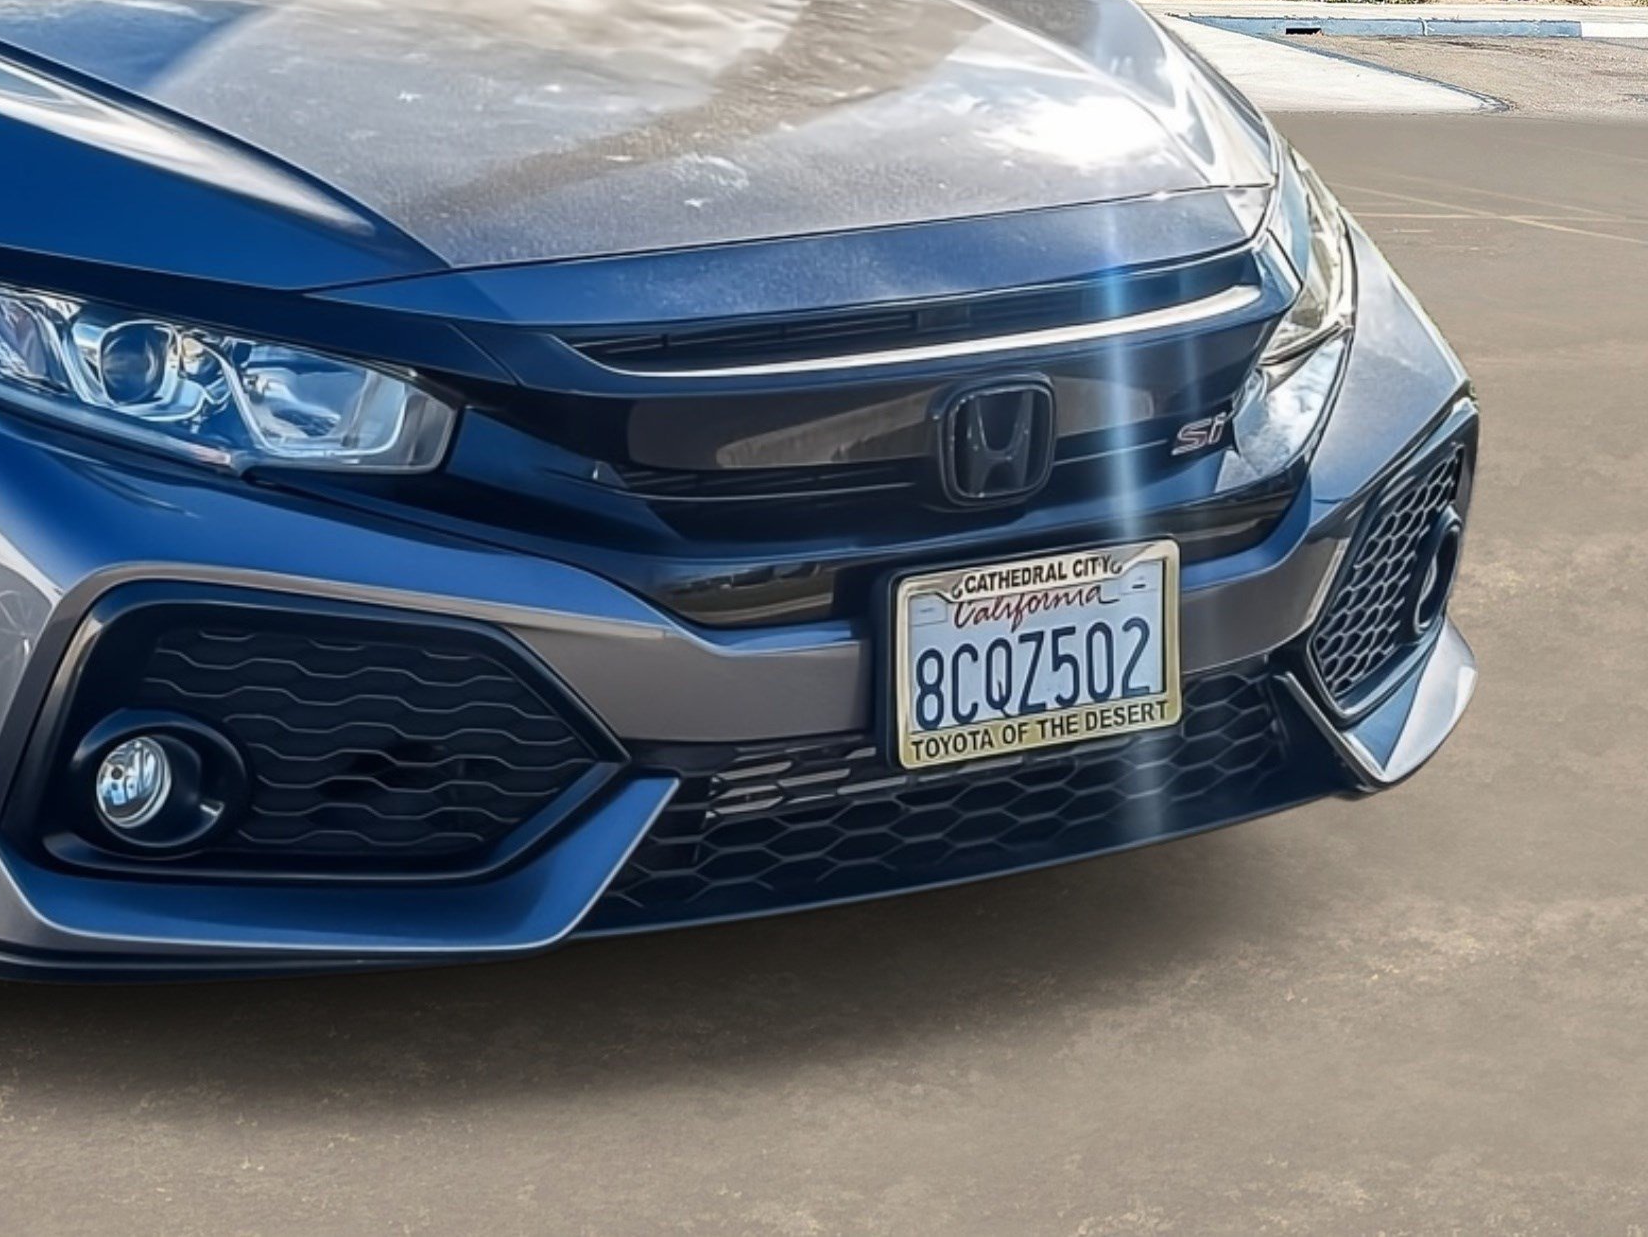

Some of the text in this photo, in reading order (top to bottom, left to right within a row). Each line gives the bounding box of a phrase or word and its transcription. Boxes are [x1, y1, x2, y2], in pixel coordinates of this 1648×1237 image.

[964, 554, 1113, 594] CATHEDRAL CITY
[953, 583, 1120, 633] California
[915, 616, 1151, 731] 8CQZ502
[911, 700, 1169, 761] TOYOTA OF THE DESERT
